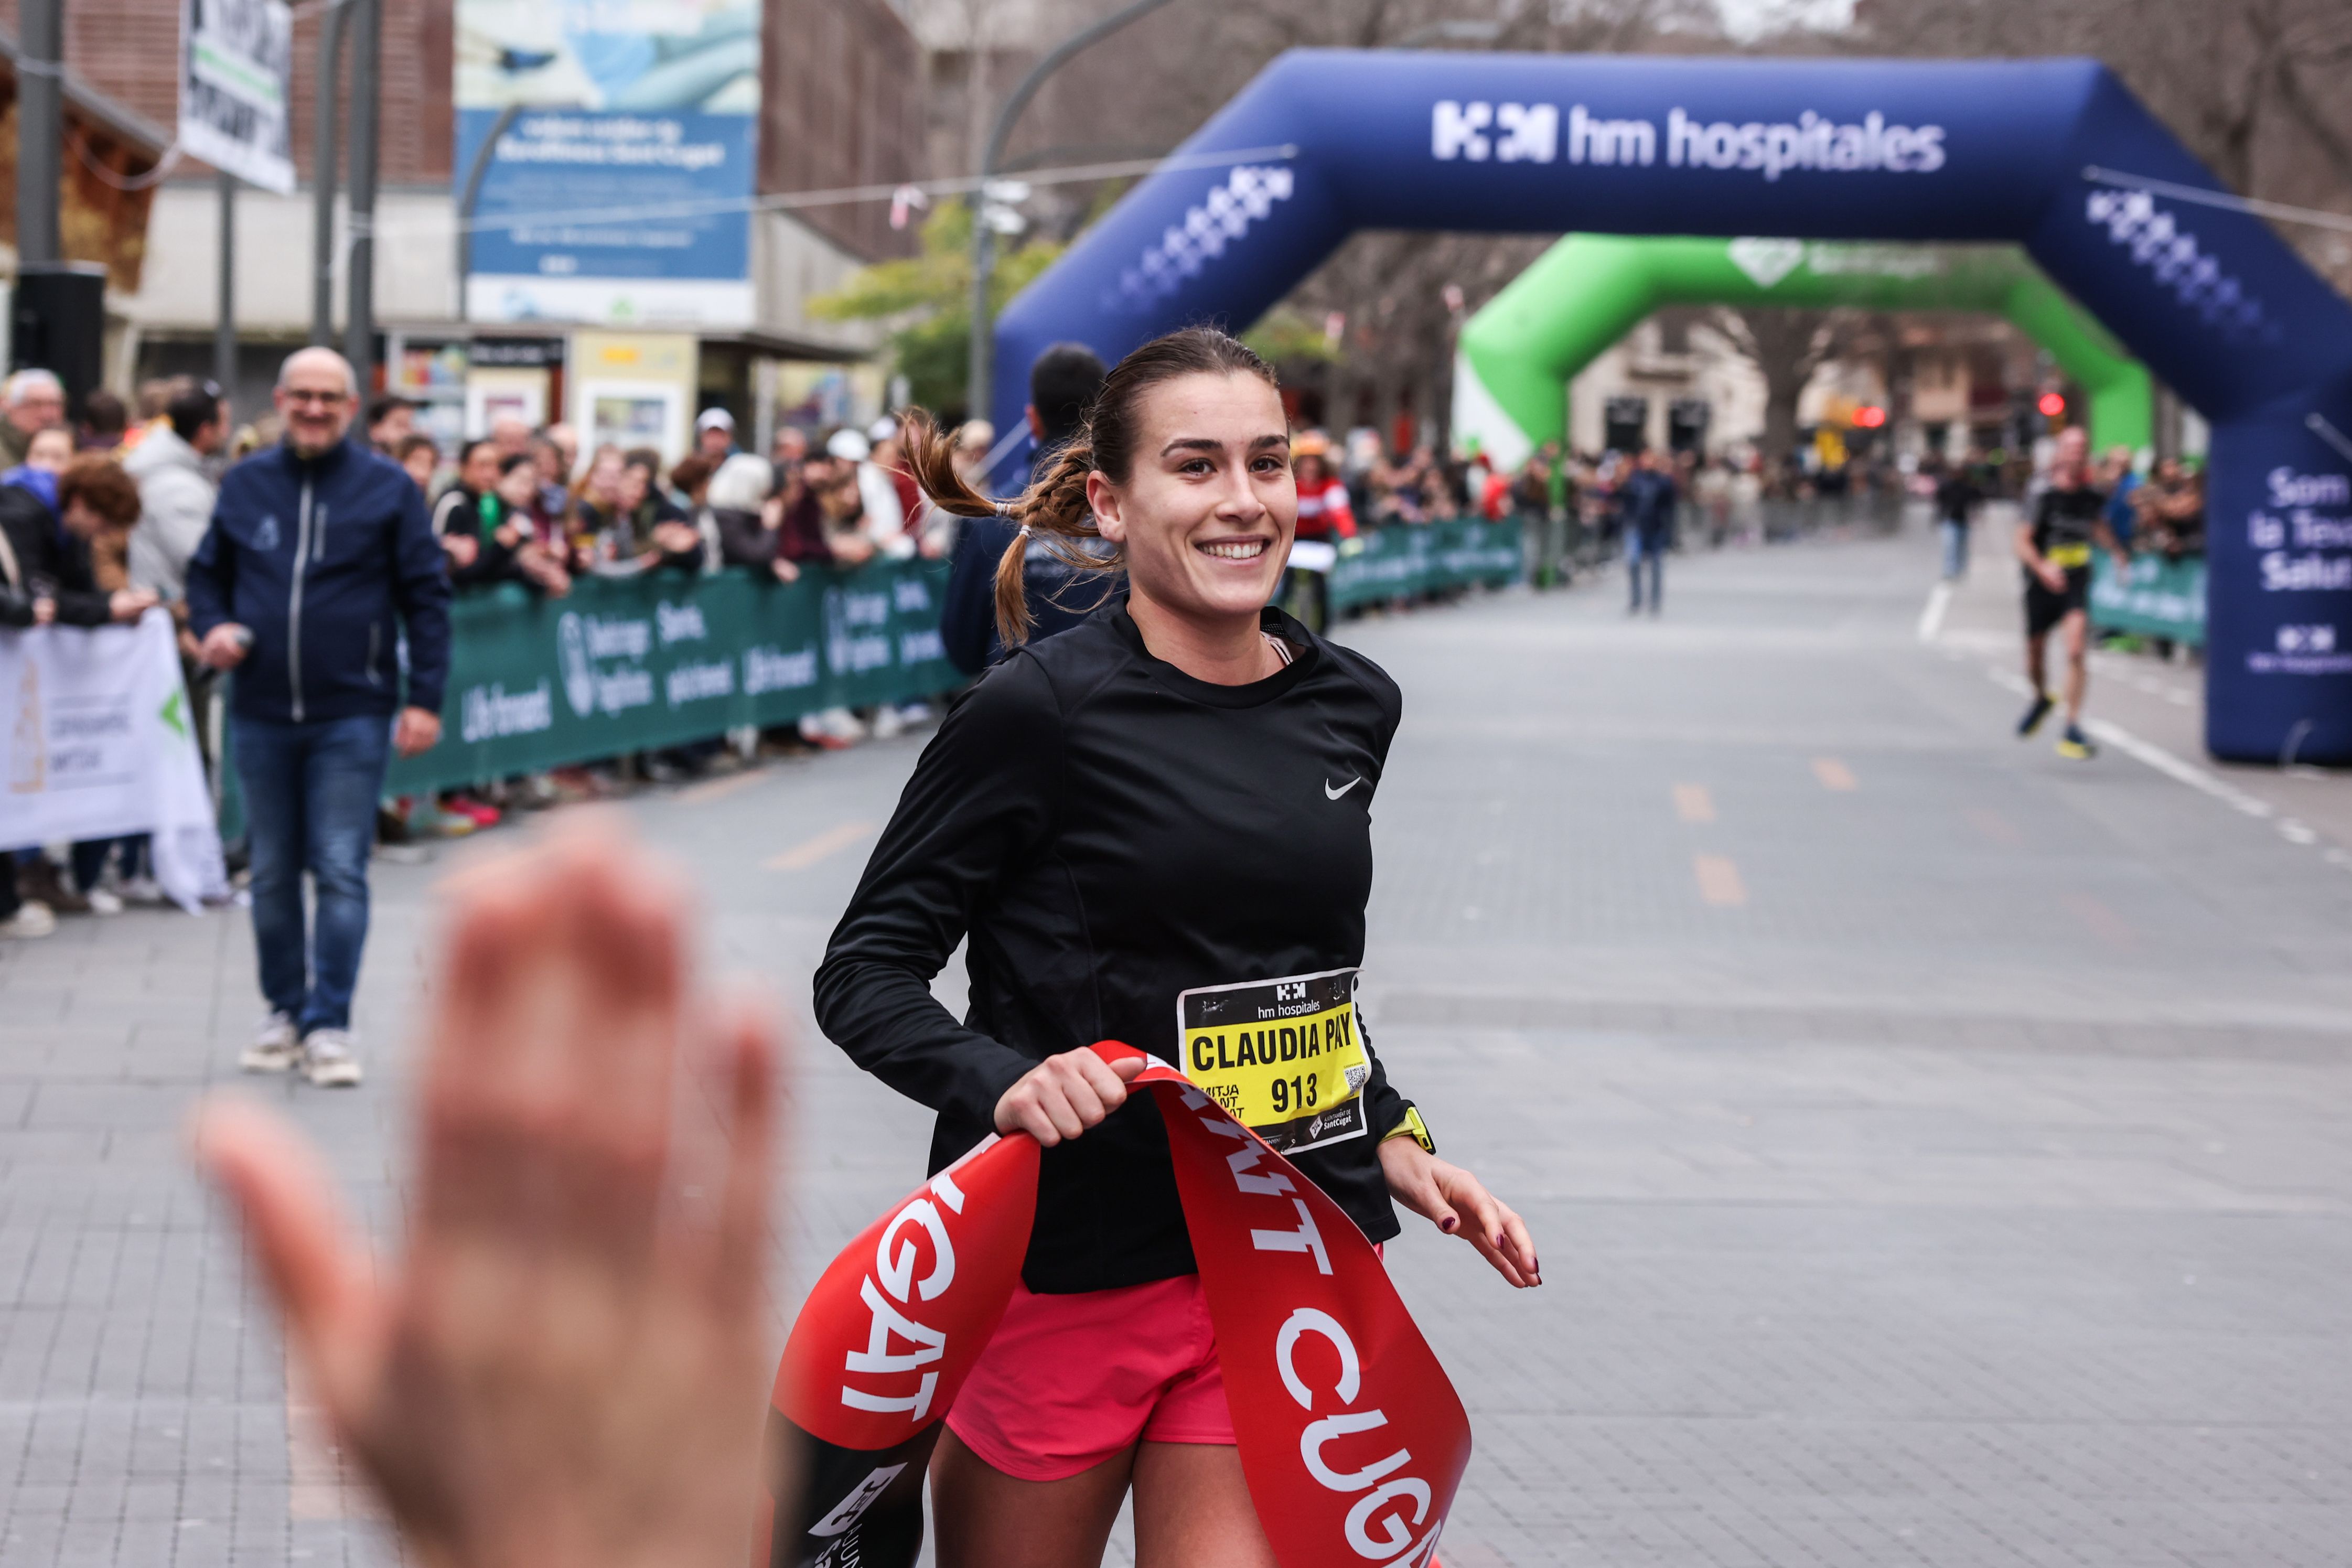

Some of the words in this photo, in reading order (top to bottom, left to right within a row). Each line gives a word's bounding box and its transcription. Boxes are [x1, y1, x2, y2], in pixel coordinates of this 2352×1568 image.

[1570, 104, 1656, 166] hm
[1667, 107, 1946, 181] hospitales
[1258, 1006, 1275, 1019] hm
[1278, 999, 1320, 1016] hospitales
[1192, 1023, 1319, 1071] CLAUDIA
[1326, 1012, 1351, 1053] PAY
[1271, 1072, 1317, 1113] 913
[1324, 1115, 1351, 1130] SantCugat
